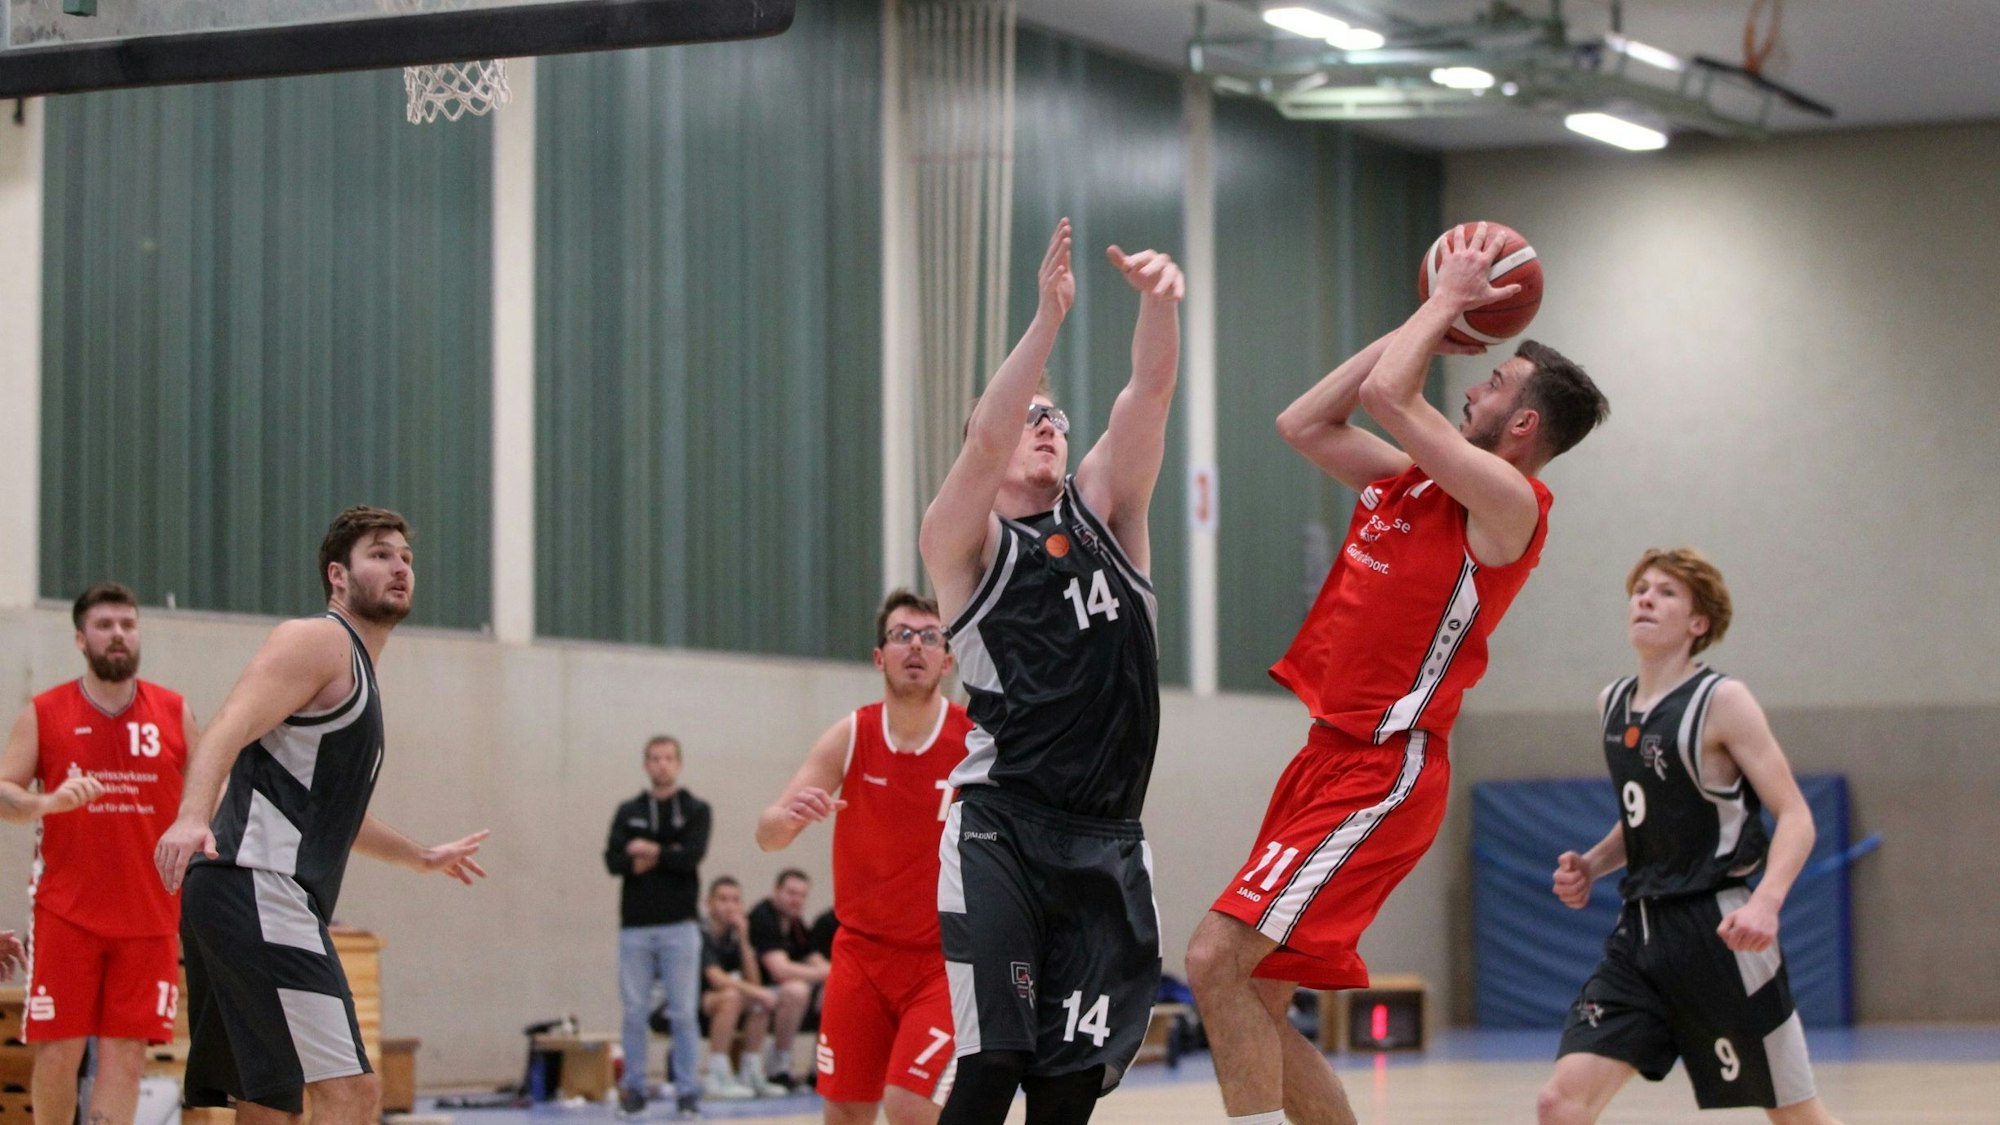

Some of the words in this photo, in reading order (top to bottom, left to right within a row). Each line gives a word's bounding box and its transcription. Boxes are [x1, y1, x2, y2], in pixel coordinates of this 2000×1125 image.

[1062, 568, 1120, 631] 14
[127, 722, 161, 757] 13
[935, 779, 954, 822] 7
[1622, 780, 1647, 829] 9
[964, 831, 998, 842] SPALDING
[1242, 841, 1300, 892] 11
[1236, 886, 1261, 903] JAKO
[156, 981, 180, 1020] 13
[1062, 990, 1111, 1048] 14
[914, 1026, 952, 1066] 7
[1714, 1037, 1741, 1082] 9
